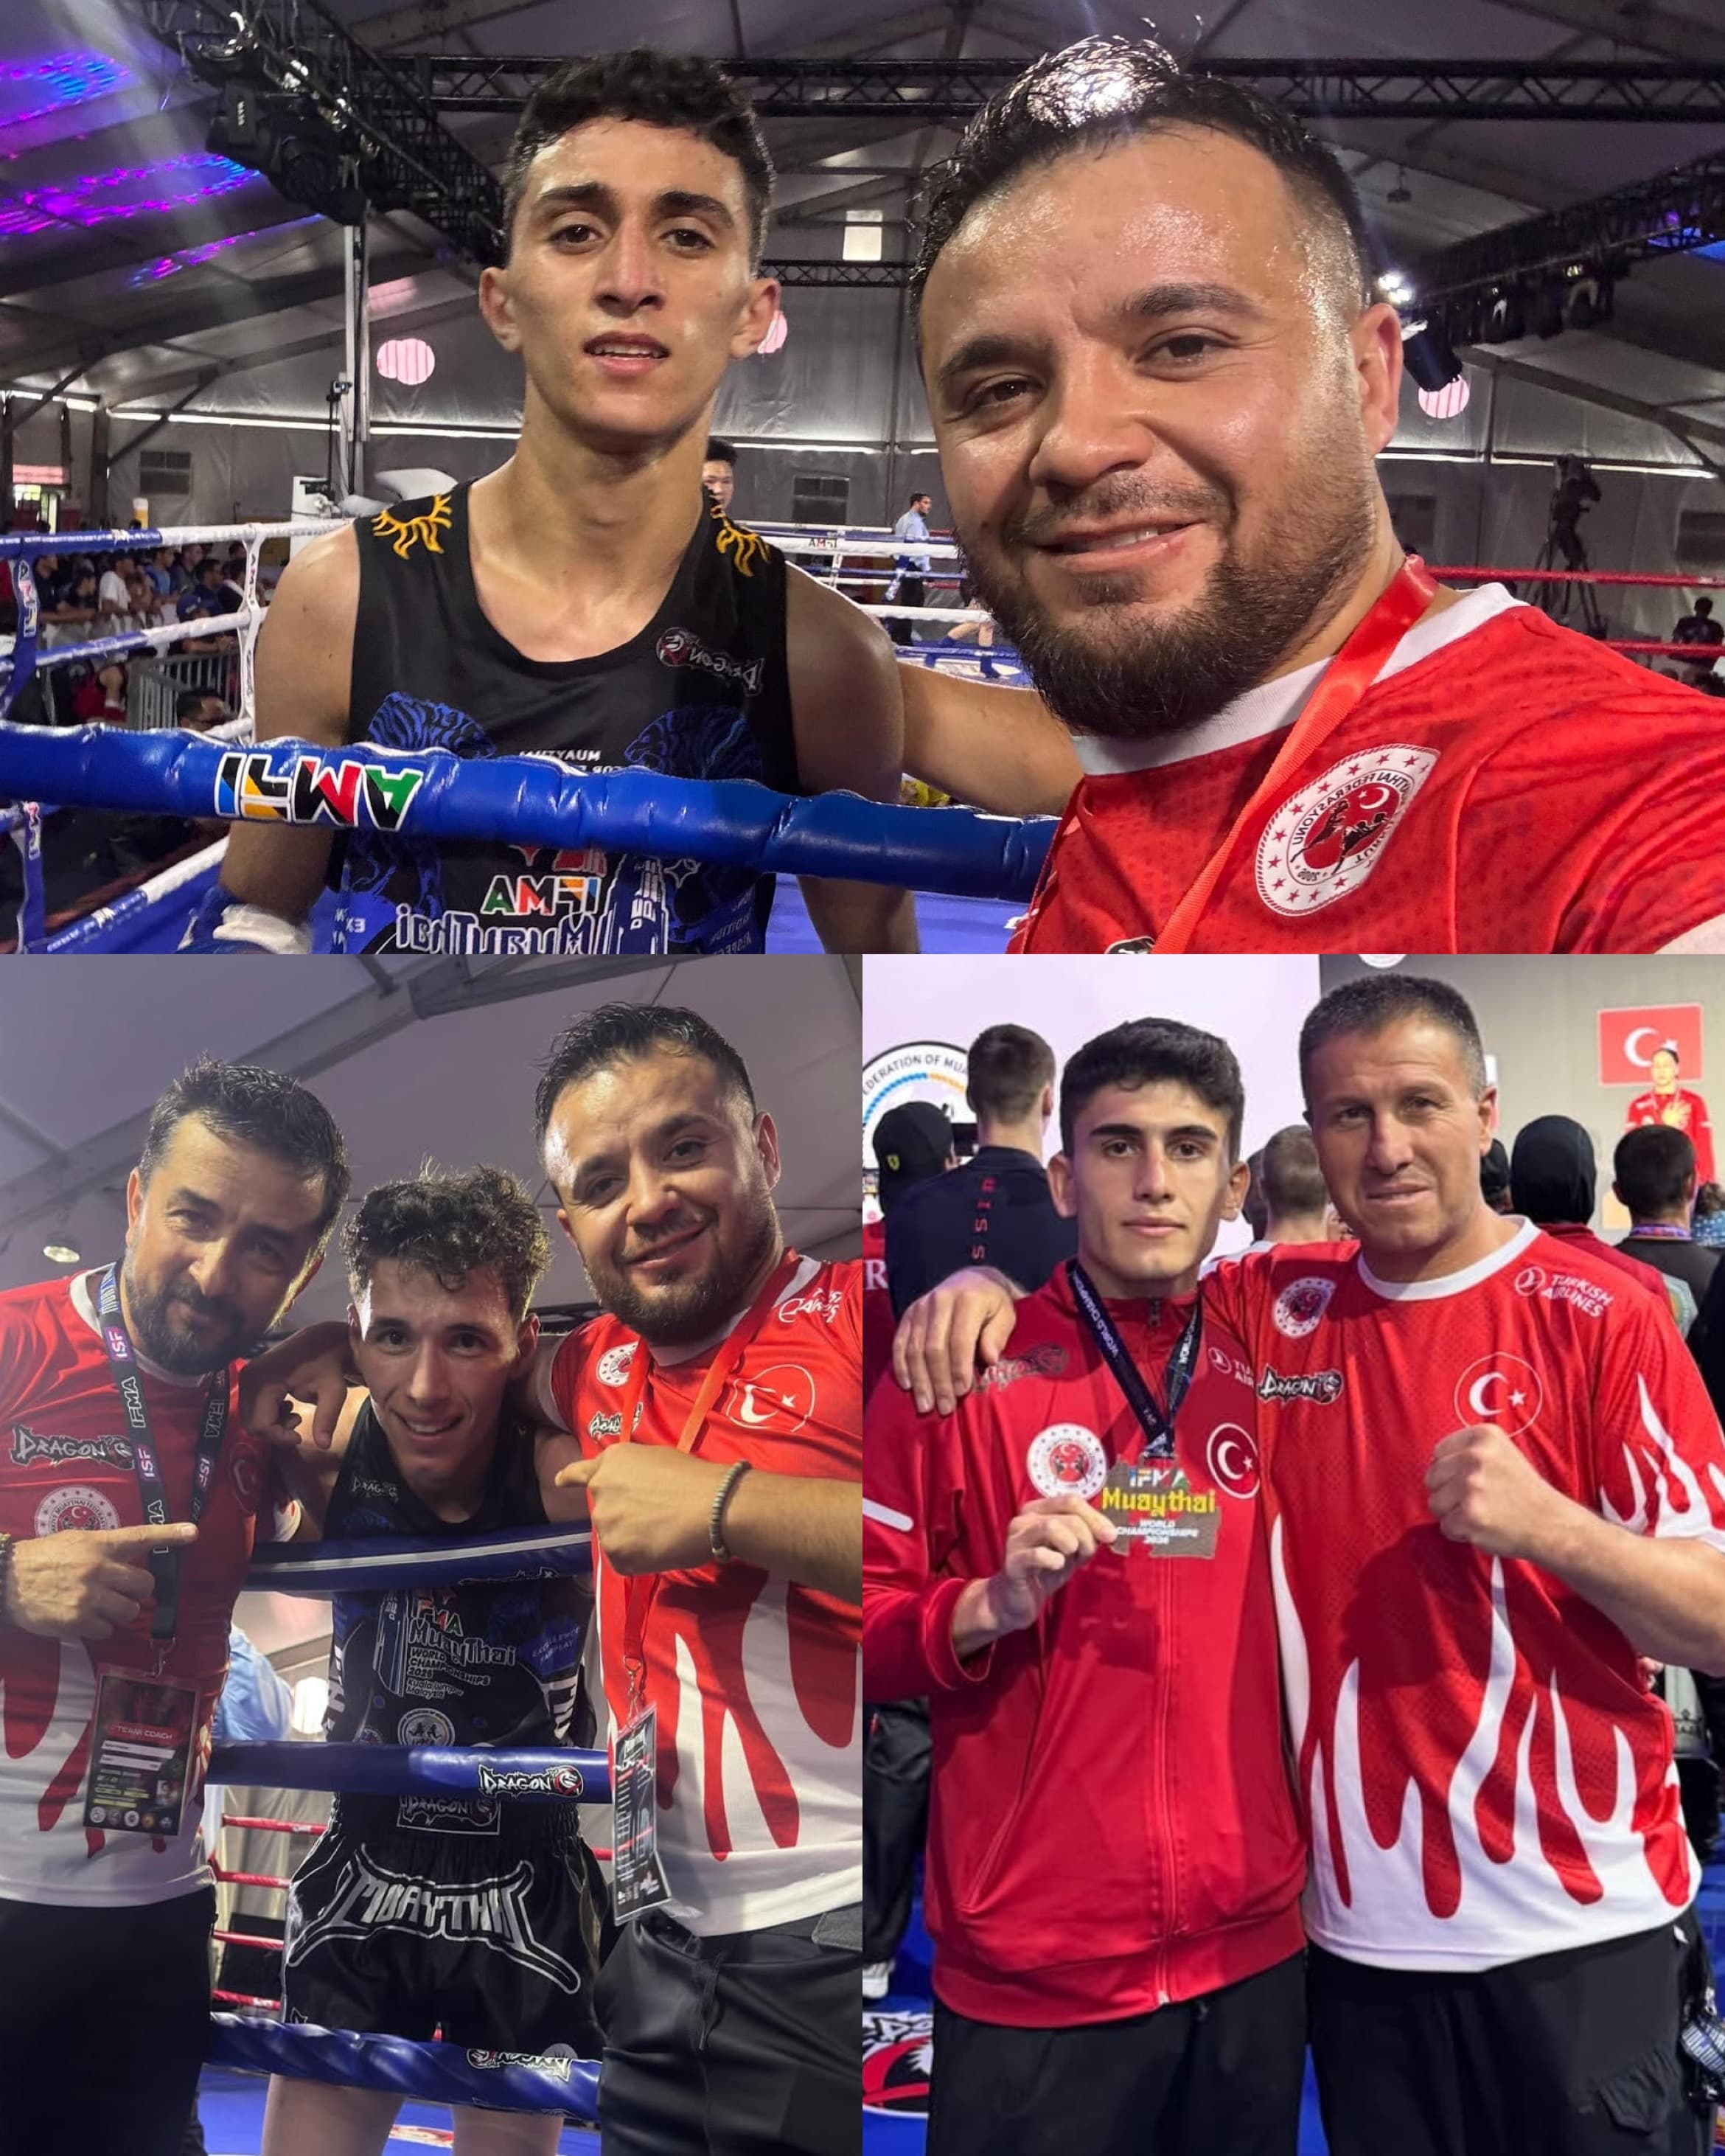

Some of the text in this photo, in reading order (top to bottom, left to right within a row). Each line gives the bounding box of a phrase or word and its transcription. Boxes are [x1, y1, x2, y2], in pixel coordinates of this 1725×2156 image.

[925, 1054, 941, 1064] OF
[1540, 1286, 1605, 1318] AIRLINES
[1552, 1274, 1614, 1307] TURKISH
[109, 1330, 128, 1358] ISF
[122, 1376, 147, 1428] IFMA
[16, 1428, 106, 1460] DRAGON
[138, 1447, 156, 1478] ISF
[1102, 1486, 1216, 1517] Muaythai
[410, 1646, 447, 1663] WORLD
[481, 1766, 551, 1797] DRAGON
